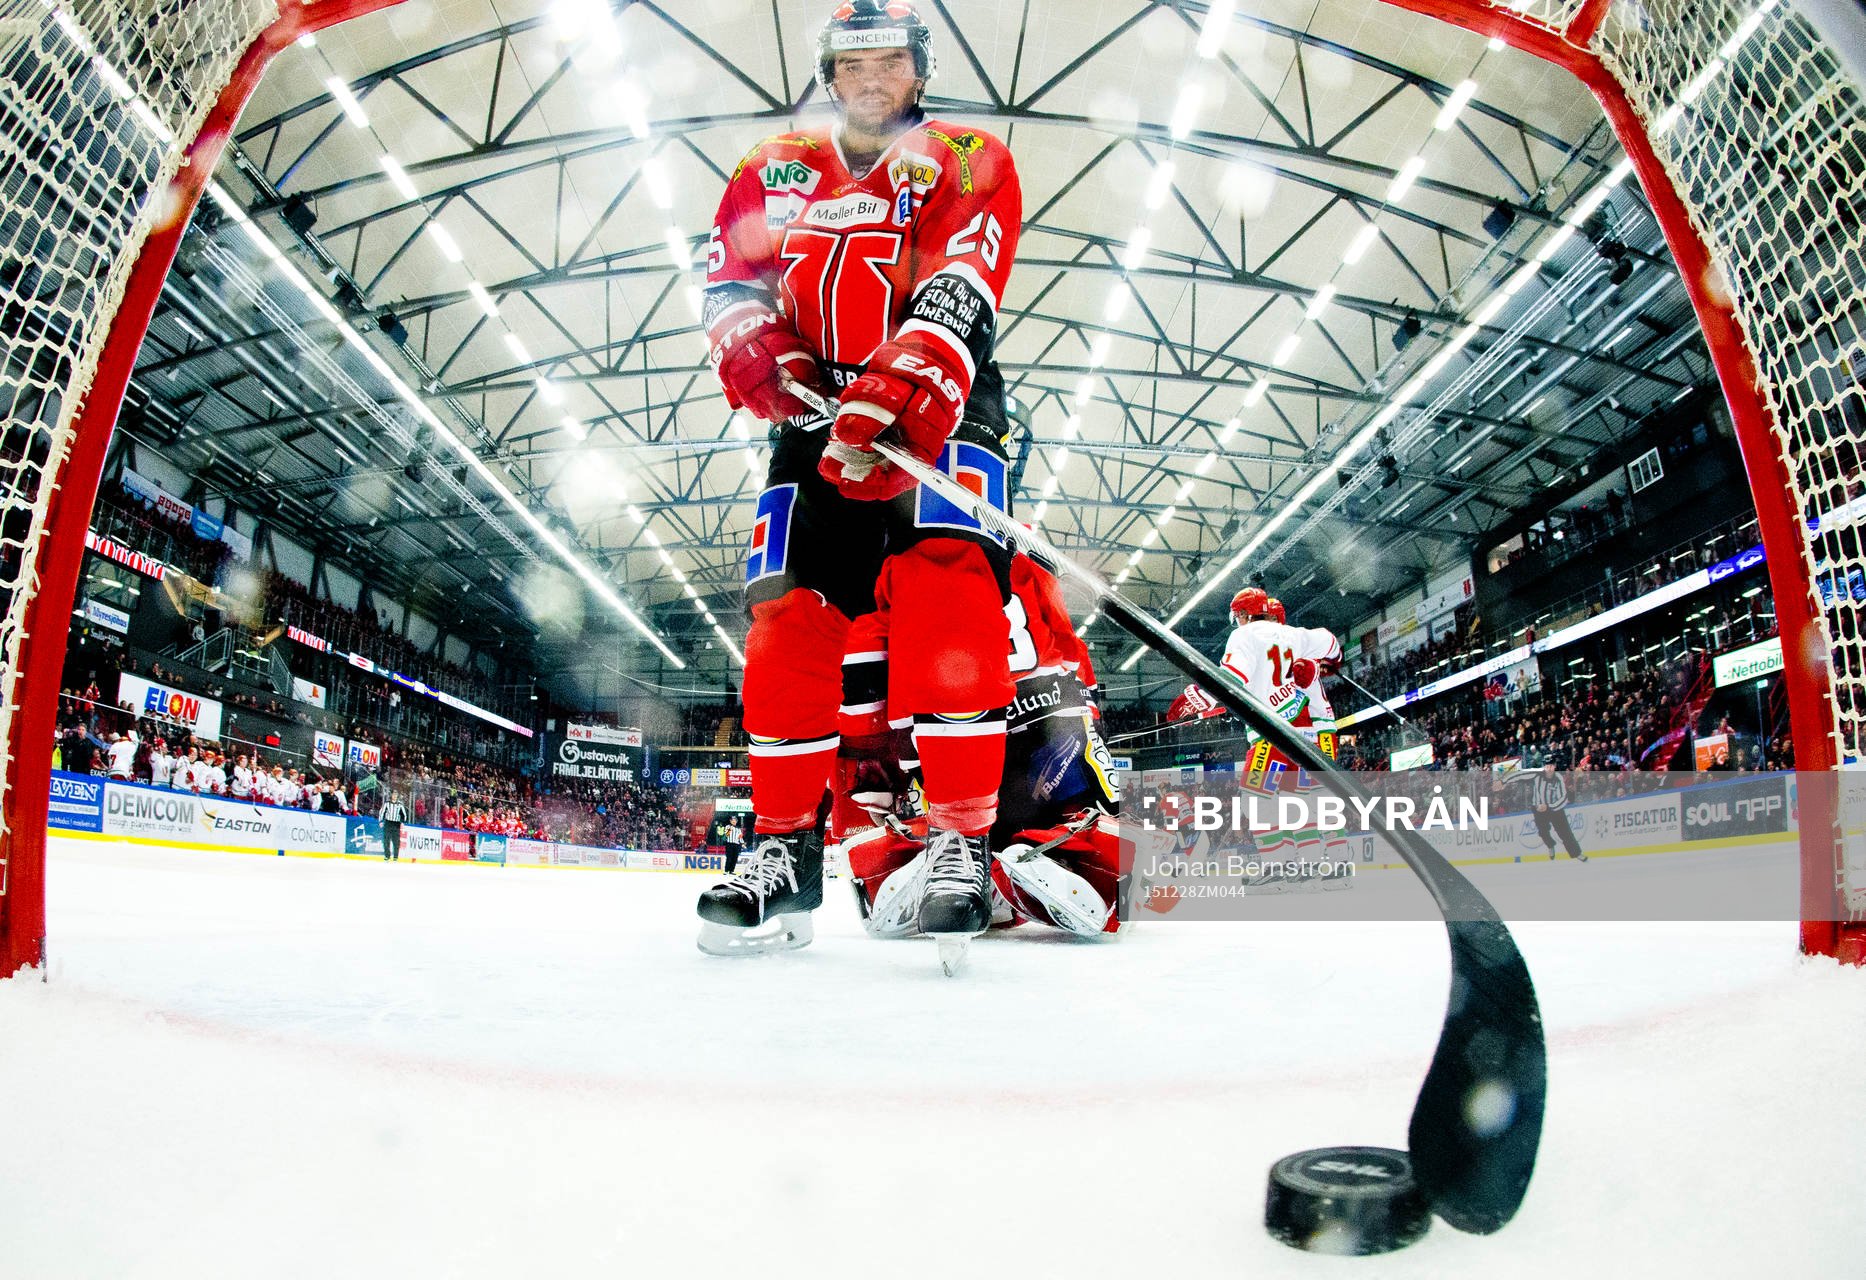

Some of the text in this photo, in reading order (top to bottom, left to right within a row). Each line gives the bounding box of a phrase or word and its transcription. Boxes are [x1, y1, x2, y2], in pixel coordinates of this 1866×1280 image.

[838, 32, 898, 45] CONCENT
[812, 205, 855, 220] Møller
[857, 201, 878, 214] Bil
[946, 211, 1002, 272] 25
[921, 288, 956, 311] SOM
[930, 278, 957, 290] DET
[969, 295, 981, 311] VI
[912, 300, 972, 340] ÖREBRO
[145, 686, 201, 724] ELON
[317, 738, 342, 756] ELON
[350, 745, 379, 765] ELON
[552, 761, 634, 783] FAMILJELÄKTARE
[107, 791, 195, 825] DEMCOM
[1613, 806, 1678, 829] PISCATOR
[1685, 802, 1732, 827] SOUL
[214, 817, 272, 834] EASTON
[290, 827, 337, 844] CONCENT
[1456, 823, 1514, 847] DEMCOM
[408, 834, 441, 851] WÜRTH
